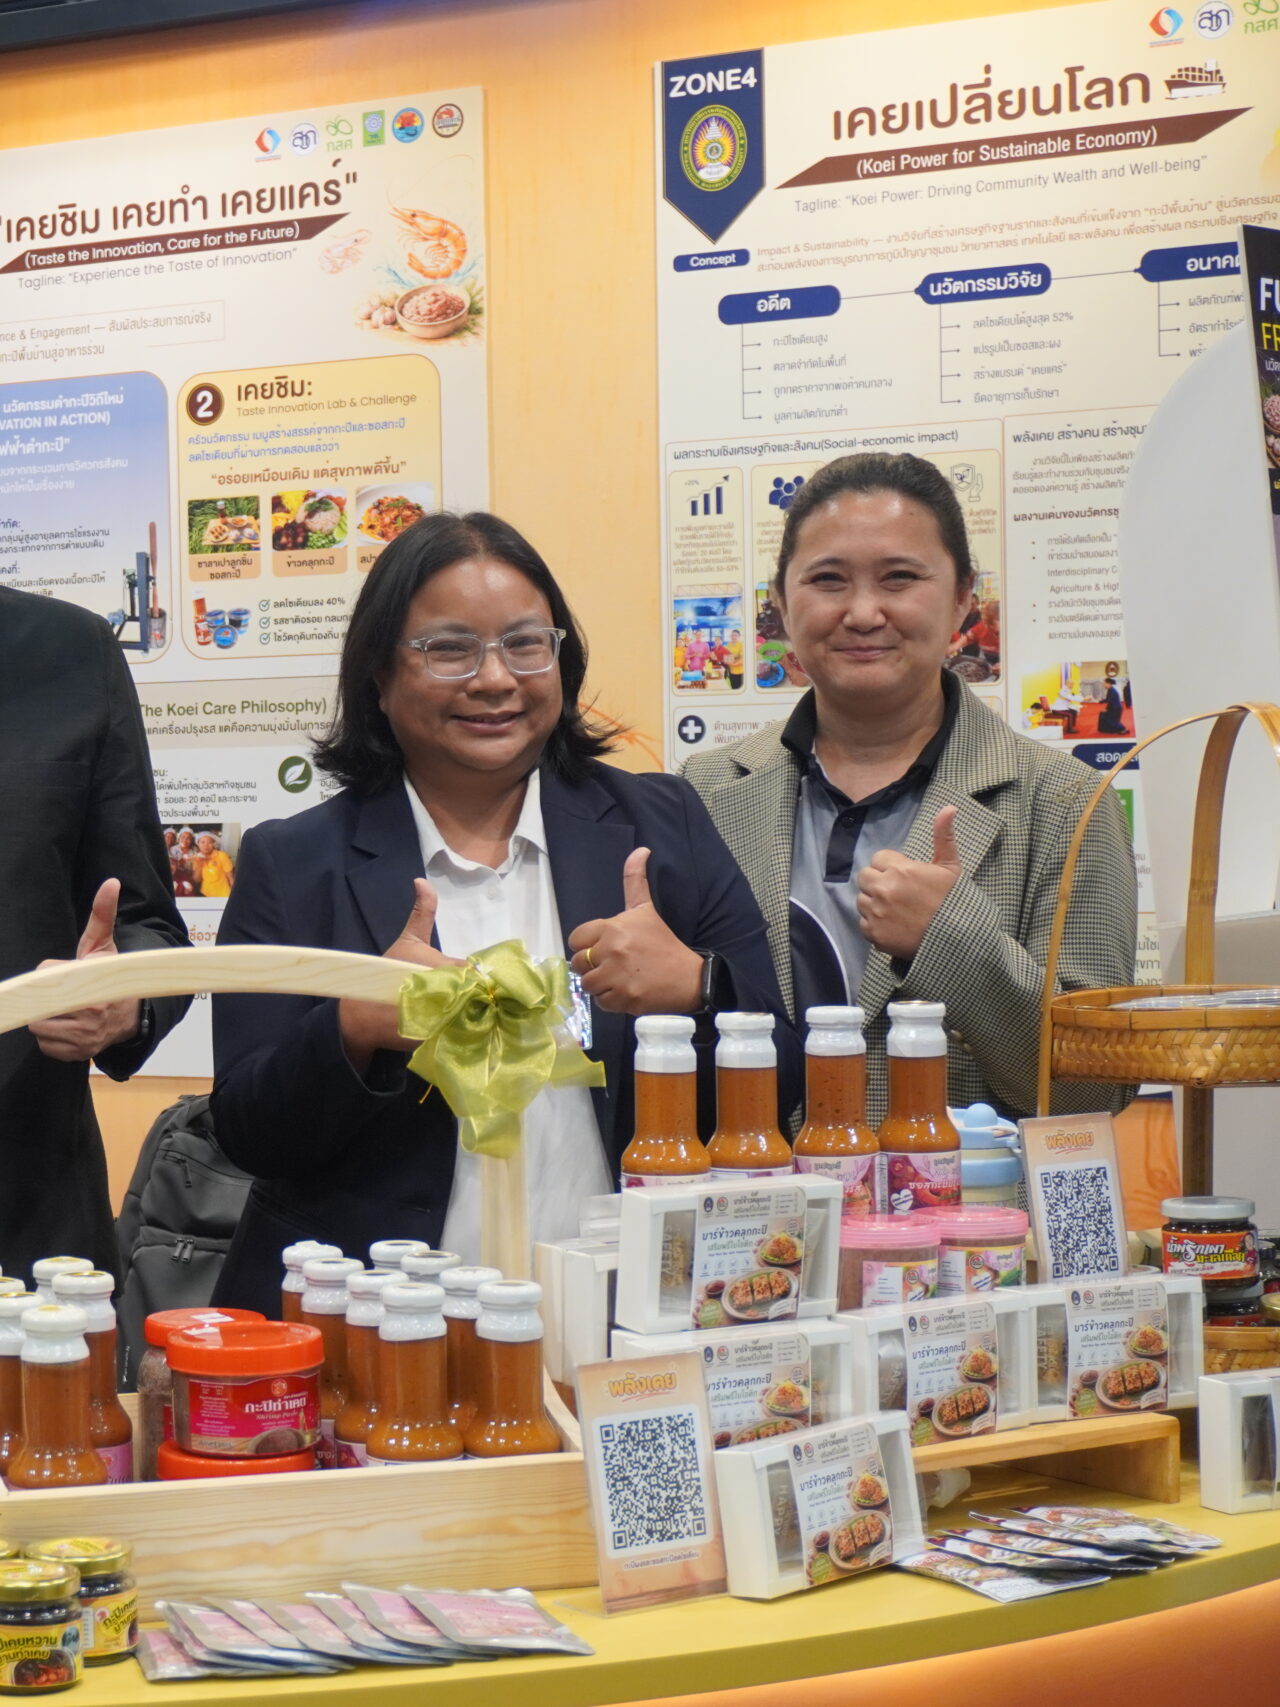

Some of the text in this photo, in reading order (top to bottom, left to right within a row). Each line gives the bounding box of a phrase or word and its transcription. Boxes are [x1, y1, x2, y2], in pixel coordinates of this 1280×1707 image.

[669, 67, 757, 97] ZONE4
[833, 63, 1151, 141] เคยเปลี่ยนโลก
[857, 125, 1158, 178] (Koei Power for Sustainable Economy)
[112, 184, 209, 231] เคยทำ
[221, 157, 358, 219] เคยแคร์"
[795, 198, 841, 213] Tagline:
[882, 189, 923, 204] Power:
[927, 181, 972, 198] Driving
[976, 172, 1049, 193] Community
[1054, 167, 1097, 184] Wealth
[1102, 165, 1125, 180] and
[25, 222, 299, 269] (Taste the Innovation, Care for the Future)
[757, 237, 870, 258] Impact & Sustainability
[690, 252, 736, 268] Concept
[18, 275, 65, 291] Tagline:
[68, 265, 147, 285] “Experience
[148, 264, 164, 274] the
[168, 258, 202, 273] Taste
[207, 255, 219, 268] of
[930, 271, 1042, 296] นวัตกรรมวิจัย
[757, 294, 791, 313] อดีต
[1053, 312, 1074, 322] 52%
[19, 329, 26, 340] &
[30, 323, 91, 340] Engagement
[237, 375, 313, 402] เคยชิม:
[196, 391, 214, 418] 2
[237, 392, 417, 417] Taste Innovation Lab & Challenge
[44, 411, 110, 426] IN ACTION)
[918, 430, 959, 444] impact)
[1013, 424, 1100, 443] พลังเคย สร้างคน
[286, 555, 335, 570] ข้าวคลุกกะปิ
[1048, 567, 1109, 576] Interdisciplinary
[209, 569, 241, 580] ซอสกะปิ
[1050, 584, 1100, 594] Agriculture &
[273, 597, 346, 609] ลดโซเดียมลง 40%
[274, 611, 323, 625] รสชาติอร่อย
[167, 697, 327, 716] Koei Care Philosophy)
[189, 795, 199, 804] 20
[1045, 1129, 1095, 1150] พลังเคย
[702, 1224, 768, 1241] บาร์ข้าวคลุกกะปิ
[1074, 1316, 1134, 1332] บาร์ข้าวคลุกกะปิ
[912, 1341, 966, 1361] บาร์ข้าวคลุกกะปิ
[608, 1370, 677, 1398] พลังเคย
[244, 1397, 306, 1413] กะปิท่าเคย
[799, 1466, 853, 1492] บาร์ข้าวคลุกกะปิ
